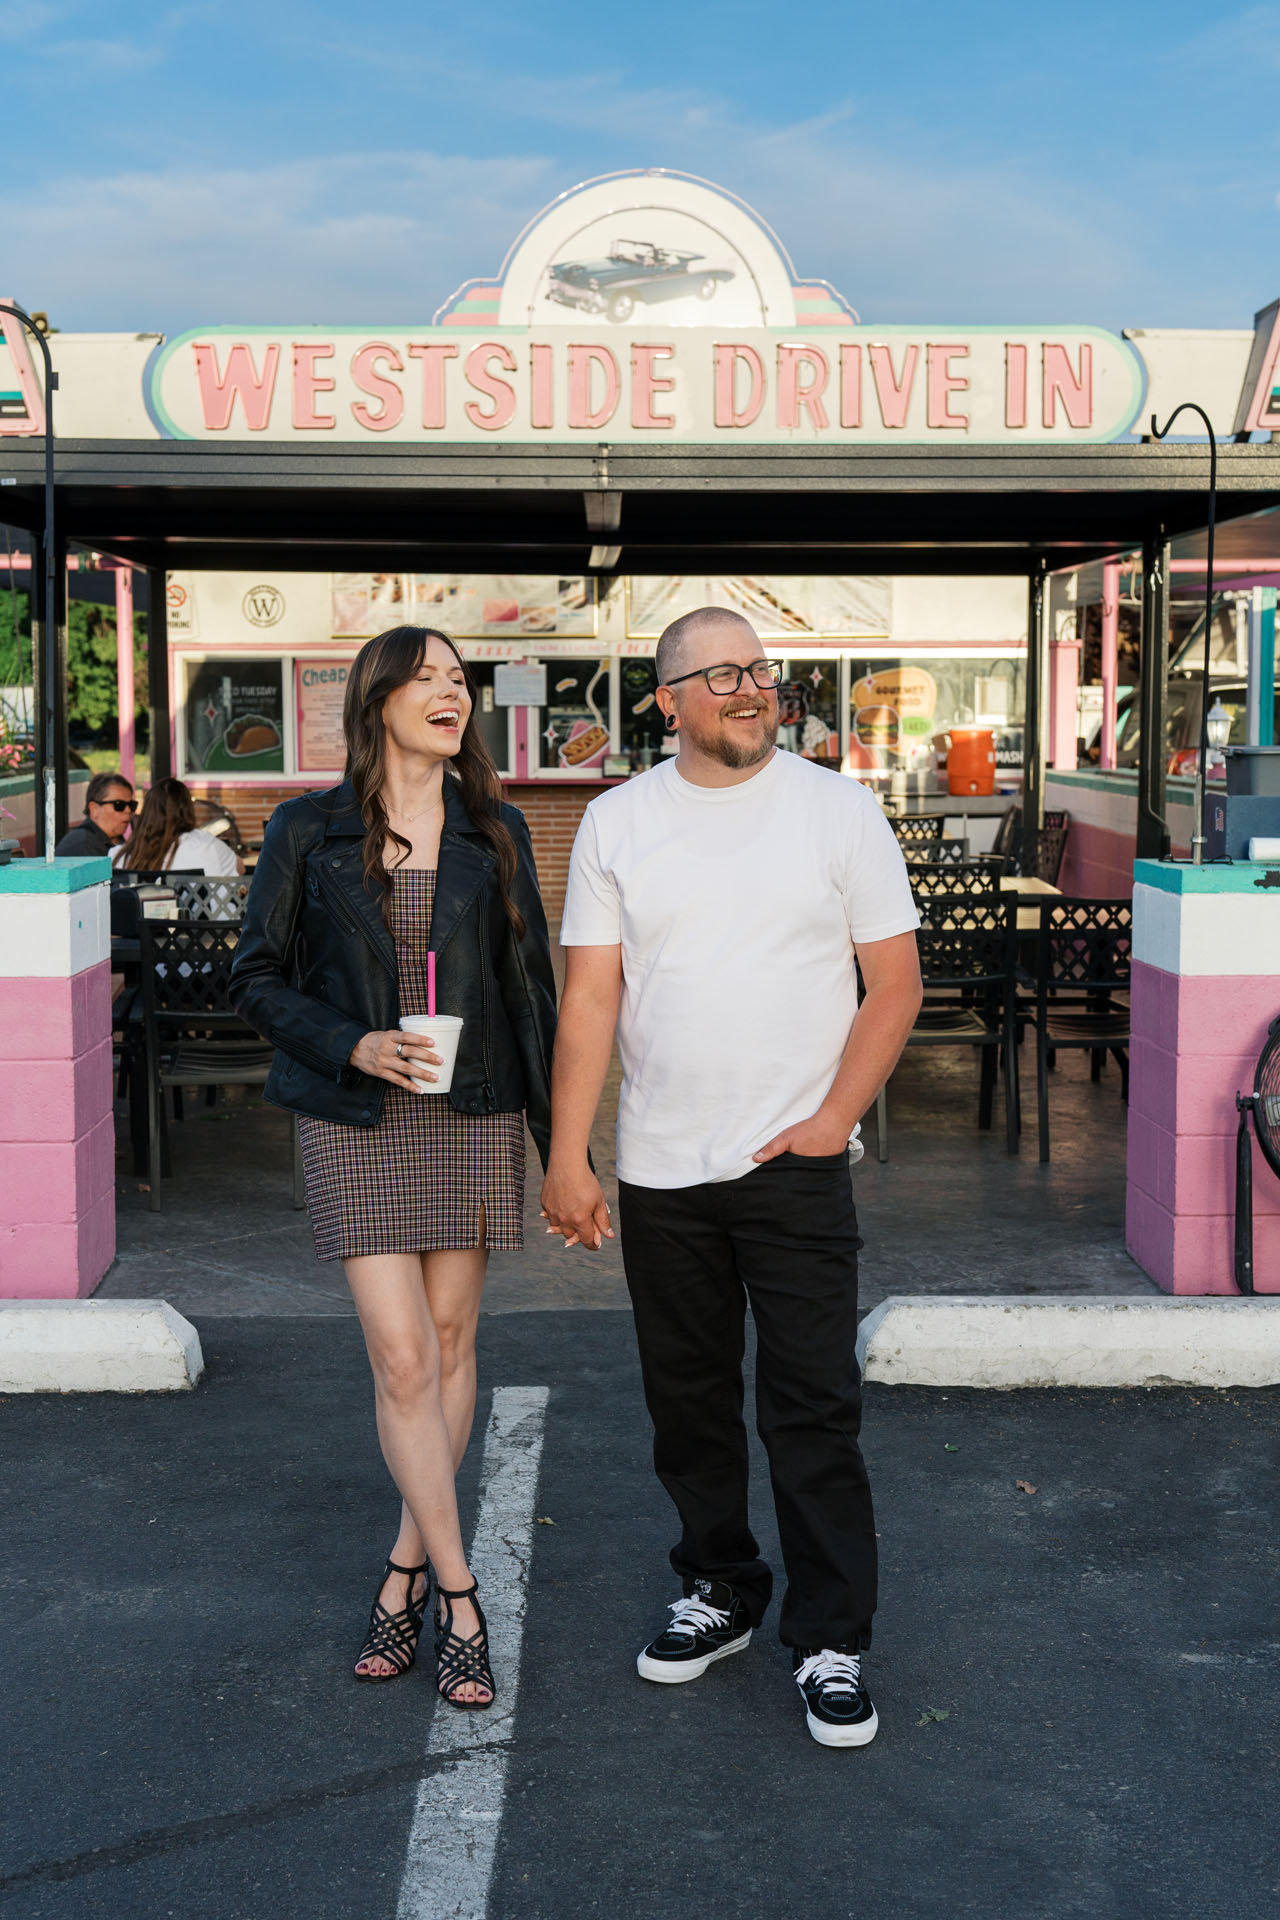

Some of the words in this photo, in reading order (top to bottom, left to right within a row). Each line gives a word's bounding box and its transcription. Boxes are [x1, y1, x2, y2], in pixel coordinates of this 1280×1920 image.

[192, 341, 676, 431] WESTSIDE
[713, 342, 970, 430] DRIVE
[1005, 342, 1093, 429] IN
[167, 621, 190, 629] MOKING
[302, 668, 347, 687] Cheap
[241, 686, 278, 697] TUESDAY
[875, 685, 926, 696] GOURMET
